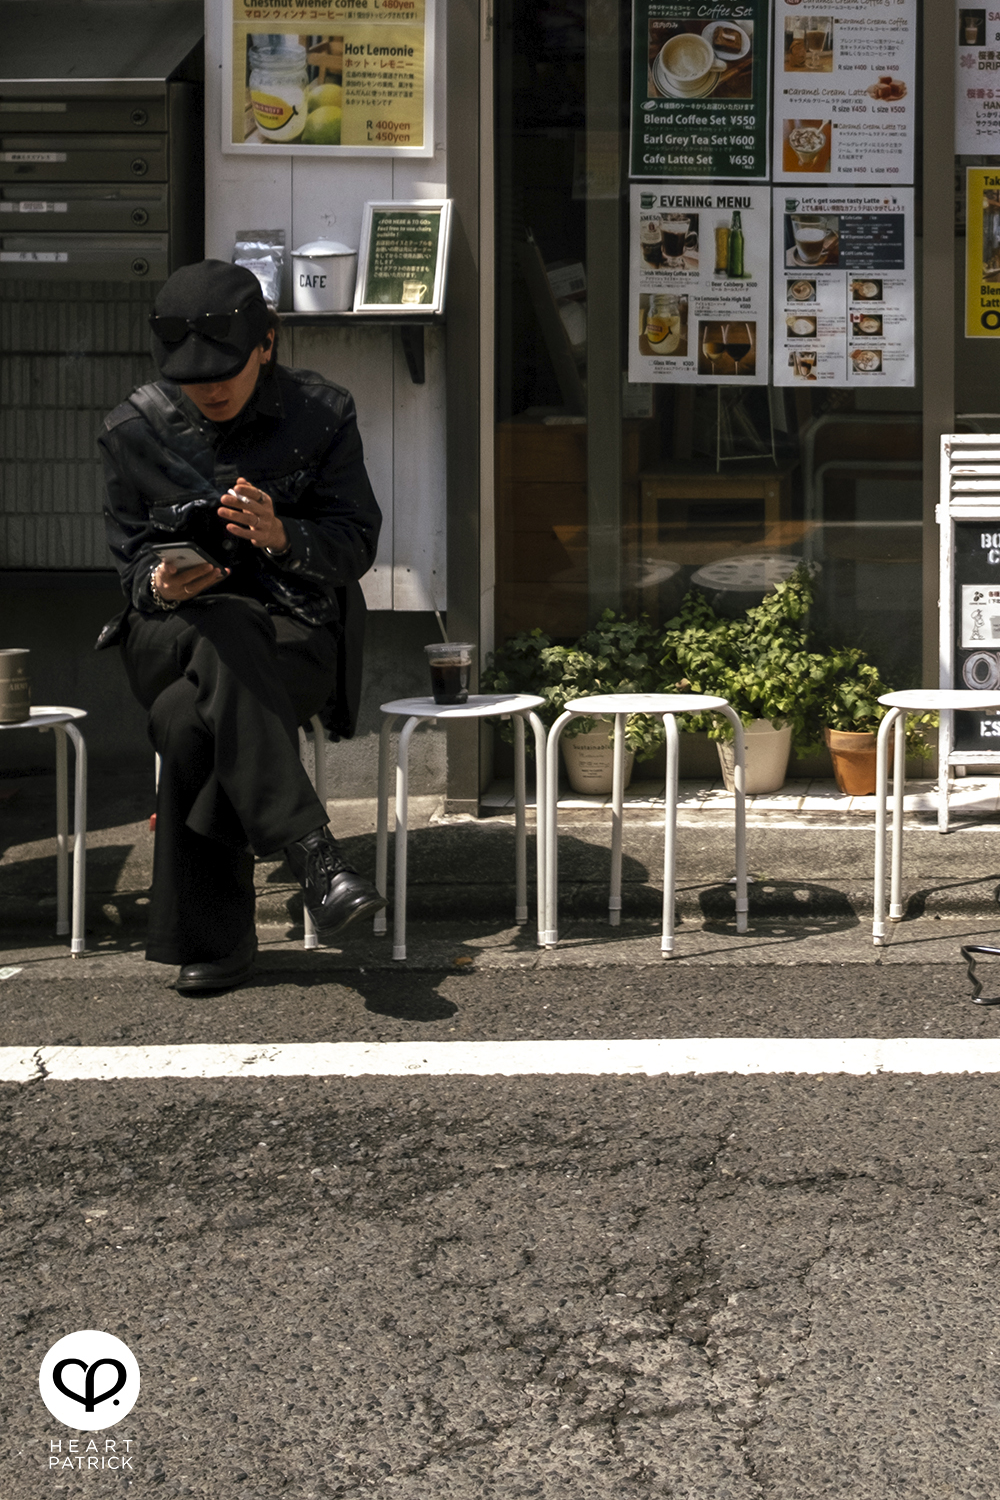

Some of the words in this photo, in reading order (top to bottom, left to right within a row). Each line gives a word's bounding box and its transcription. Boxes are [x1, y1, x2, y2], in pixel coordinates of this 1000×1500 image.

[374, 0, 380, 8] L
[382, 0, 414, 11] 480yen
[310, 11, 344, 19] コーヒー
[697, 5, 731, 19] Coffee
[731, 6, 753, 18] Set
[345, 43, 364, 55] Hot
[366, 44, 414, 57] Lemonie
[788, 88, 820, 96] Caramel
[822, 89, 846, 97] Cream
[366, 120, 373, 129] R
[376, 121, 411, 132] 400yen
[644, 114, 673, 125] Blend
[675, 114, 708, 125] Coffee
[710, 115, 727, 125] Set
[730, 116, 756, 126] ¥550
[366, 132, 373, 141] L
[376, 132, 411, 144] 450yen
[644, 134, 664, 144] Earl
[665, 134, 690, 147] Grey
[690, 135, 709, 145] Tea
[711, 135, 728, 145] Set
[729, 135, 755, 145] ¥600
[643, 153, 666, 164] Cafe
[668, 154, 694, 164] Latte
[696, 155, 713, 165] Set
[729, 155, 755, 165] ¥650
[660, 195, 712, 208] EVENING
[716, 196, 751, 209] MENU
[818, 198, 828, 206] get
[847, 198, 862, 206] tasty
[299, 274, 327, 289] CAFE
